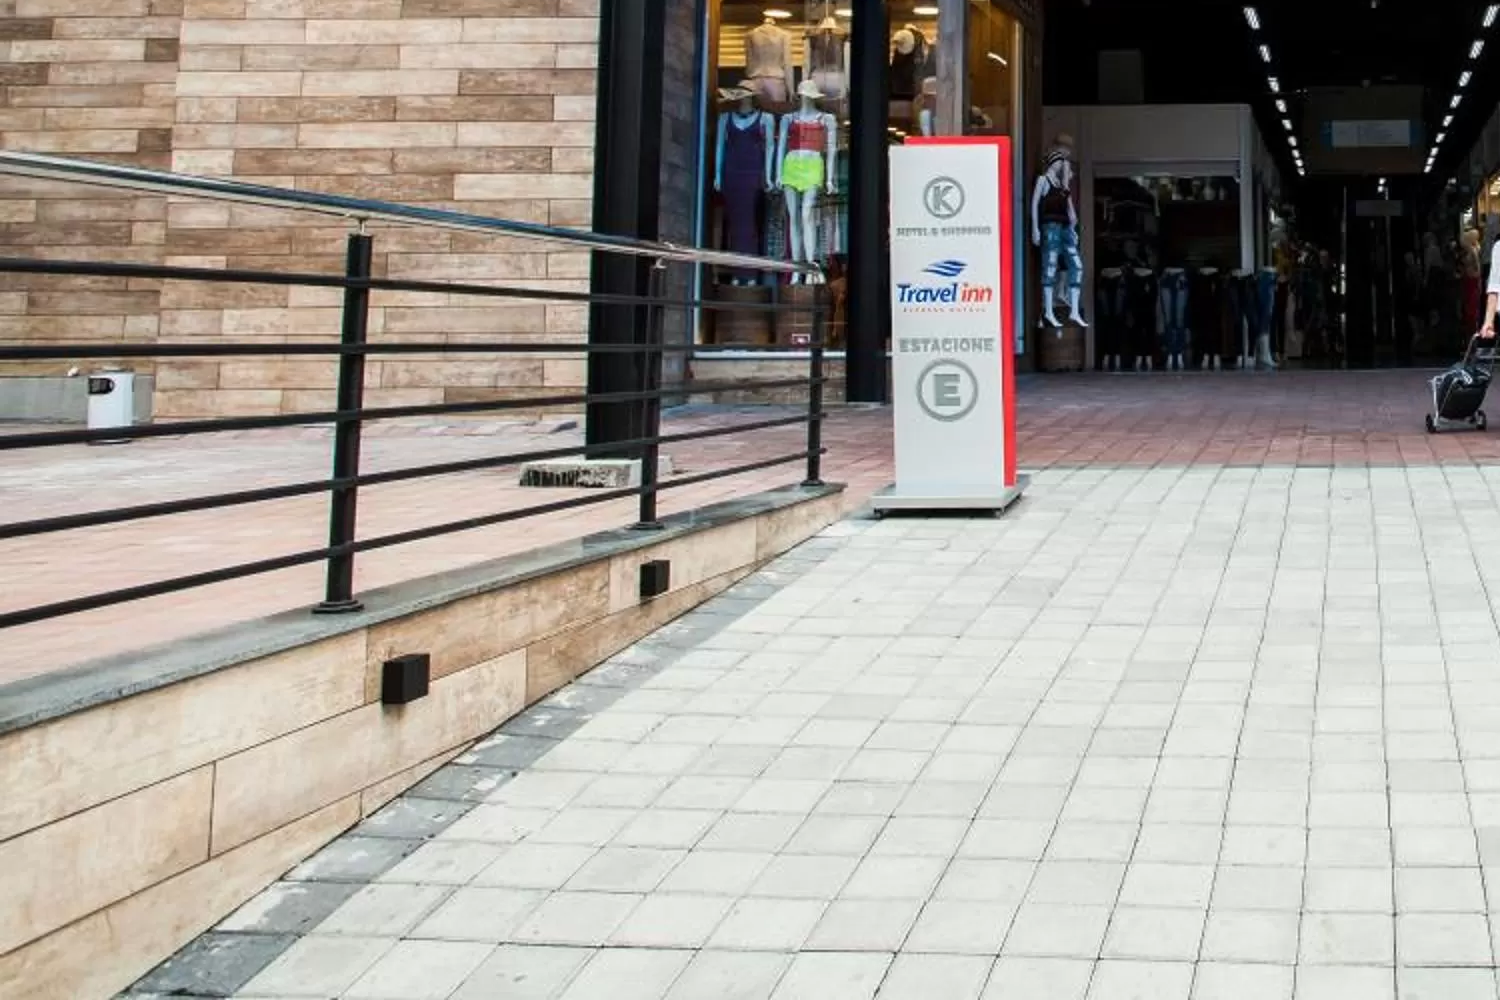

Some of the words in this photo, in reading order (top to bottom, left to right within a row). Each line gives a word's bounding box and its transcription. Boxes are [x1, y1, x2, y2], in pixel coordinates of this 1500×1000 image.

[896, 282, 958, 303] Travel
[960, 282, 993, 303] inn
[898, 337, 995, 353] ESTACIONE
[933, 373, 961, 407] E
